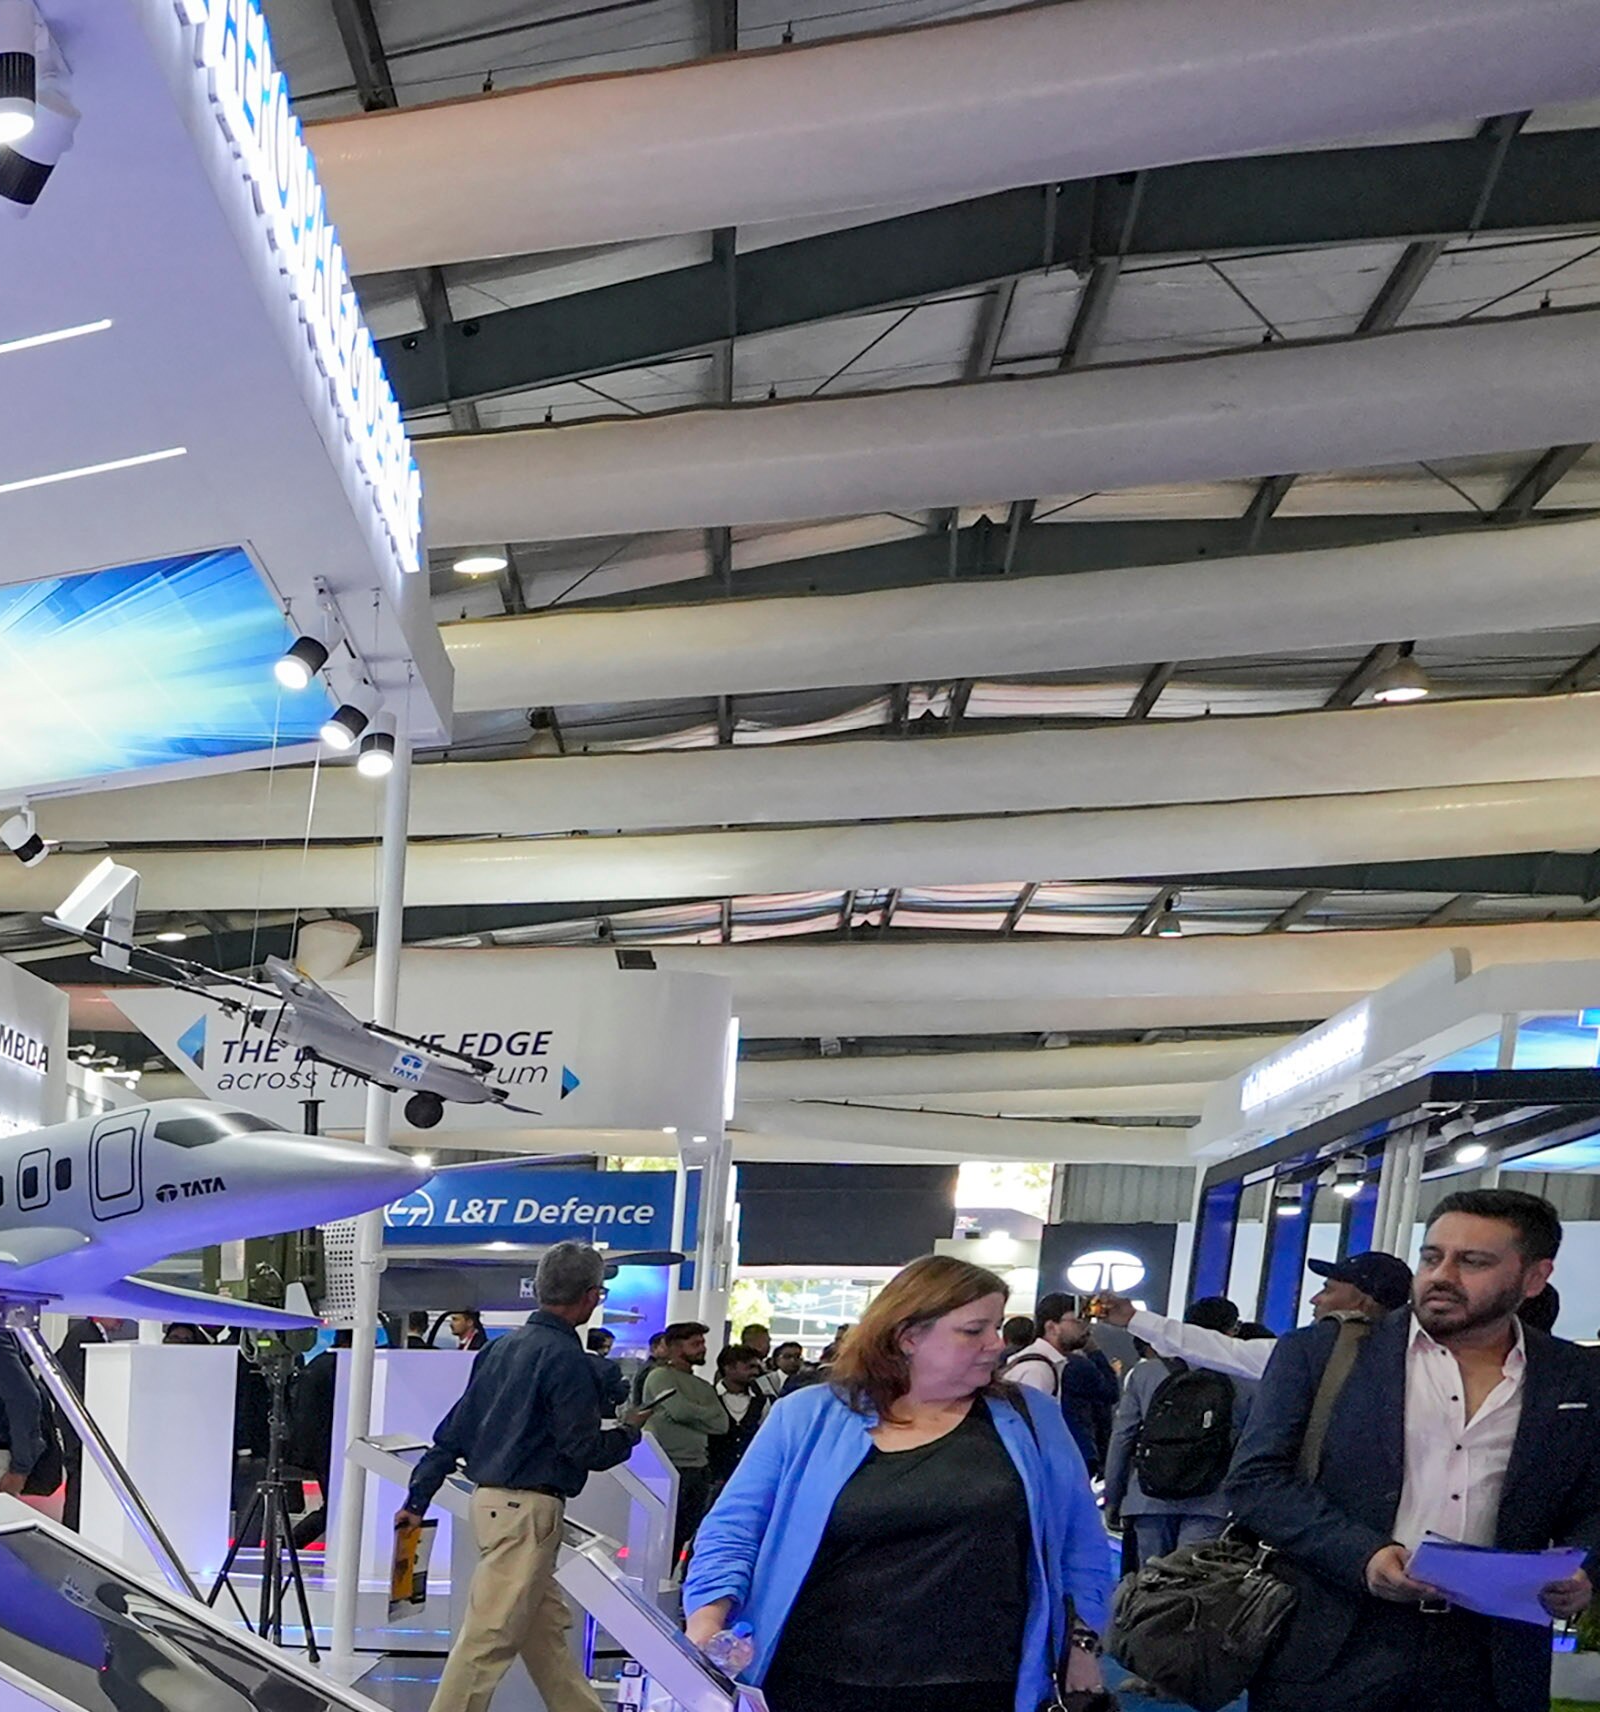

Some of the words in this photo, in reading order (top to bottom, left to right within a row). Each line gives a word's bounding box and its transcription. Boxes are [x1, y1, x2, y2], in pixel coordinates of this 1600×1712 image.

[222, 1040, 282, 1063] THE
[458, 1031, 553, 1057] EDGE
[217, 1071, 319, 1090] across
[393, 1066, 419, 1082] TATA
[180, 1176, 227, 1198] TATA
[444, 1198, 507, 1224] L&T
[513, 1197, 655, 1225] Defence
